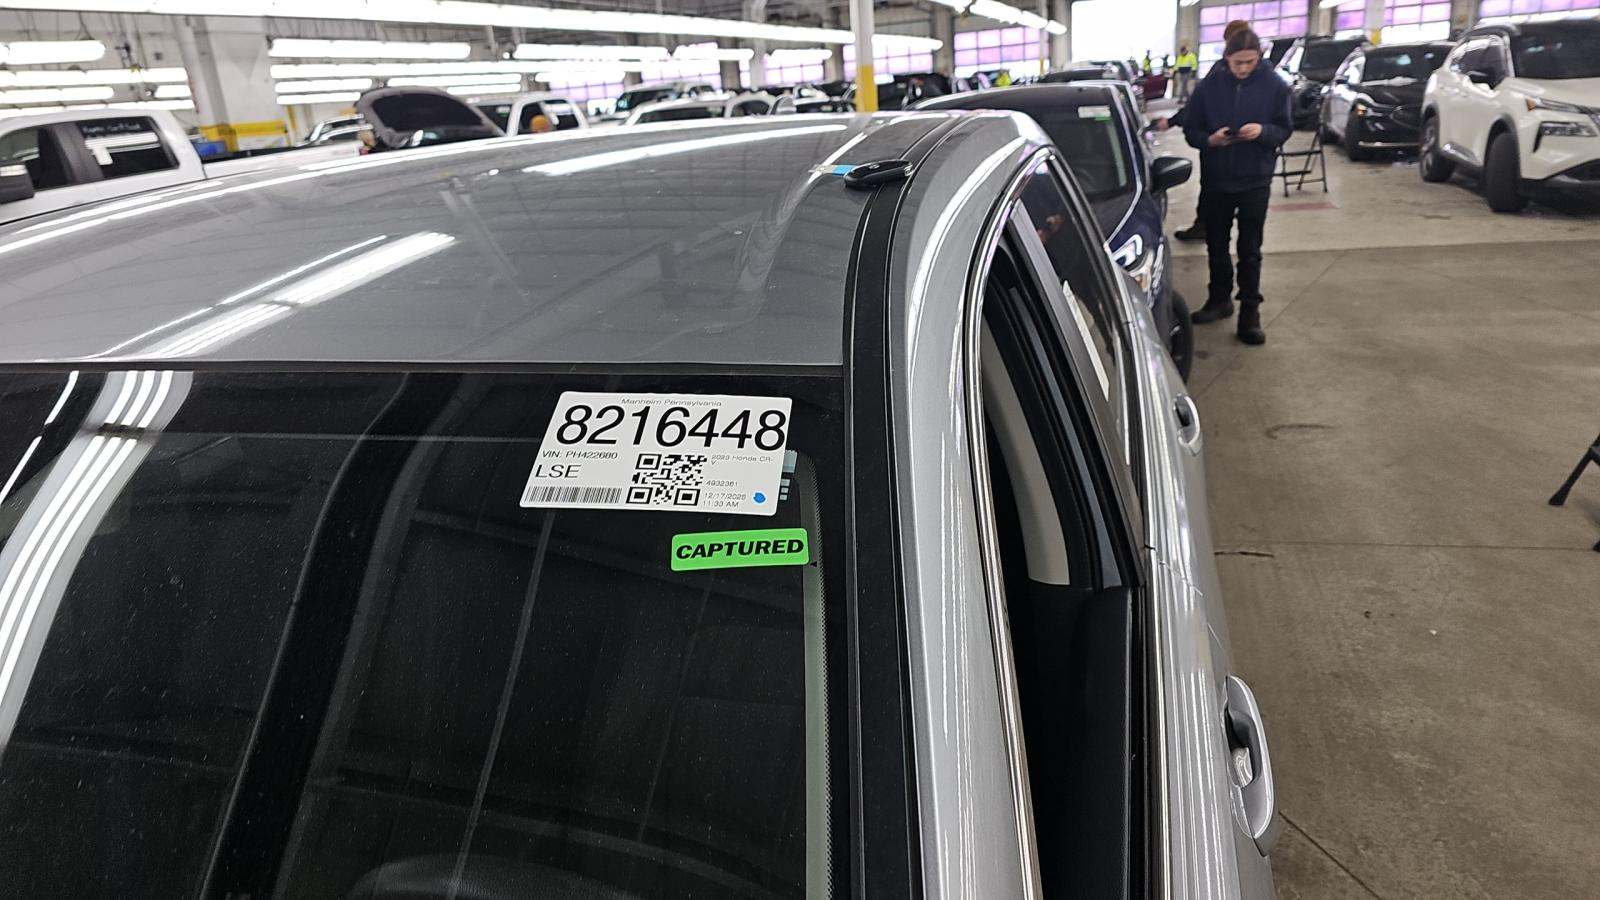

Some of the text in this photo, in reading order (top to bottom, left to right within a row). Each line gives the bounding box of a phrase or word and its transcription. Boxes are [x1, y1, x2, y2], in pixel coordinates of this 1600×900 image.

[621, 398, 722, 407] Manheim Pennsylvania
[556, 405, 786, 451] 8216448
[542, 450, 562, 458] VIN:
[535, 464, 581, 478] LSE
[676, 539, 804, 560] CAPTURED
